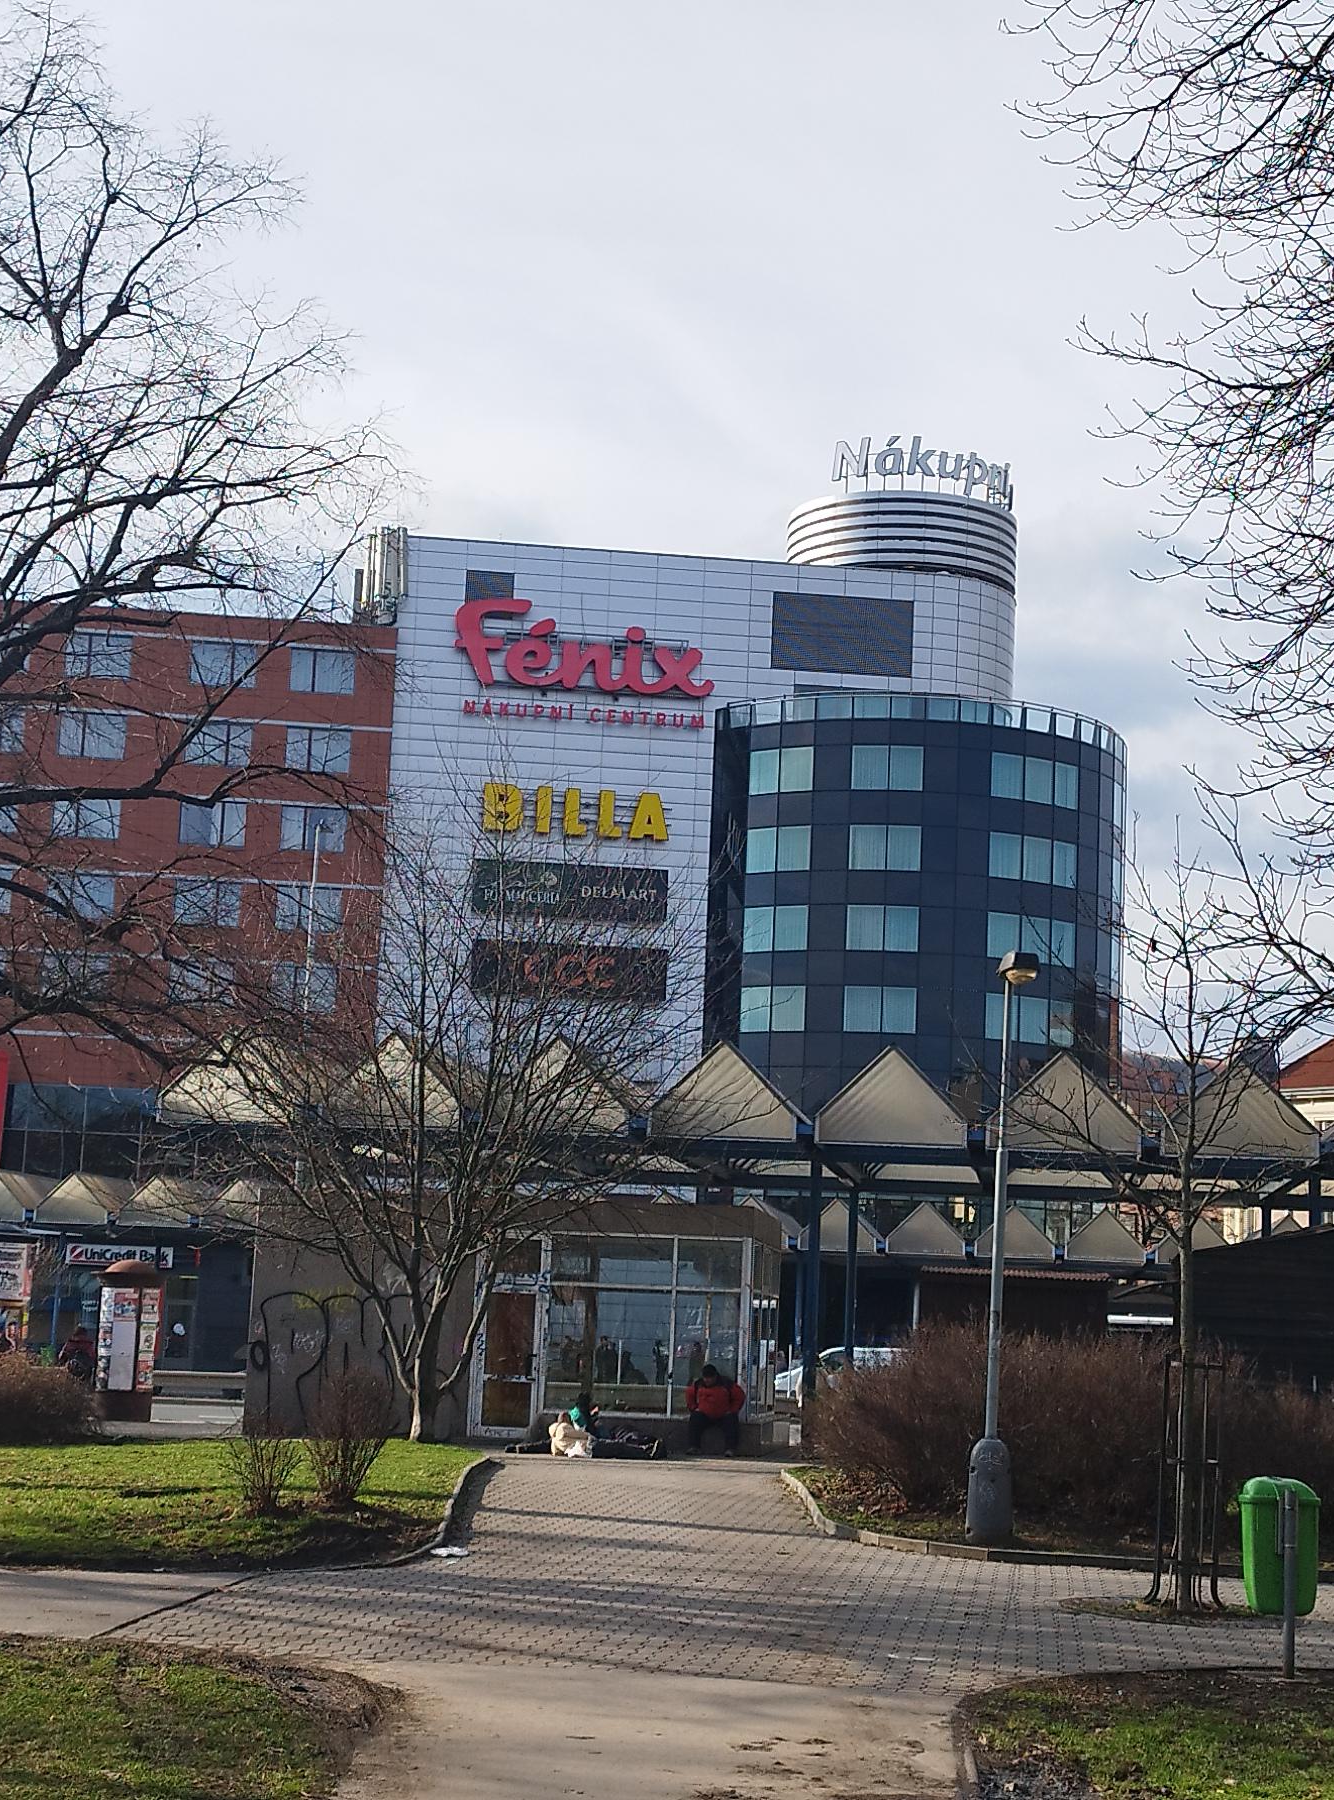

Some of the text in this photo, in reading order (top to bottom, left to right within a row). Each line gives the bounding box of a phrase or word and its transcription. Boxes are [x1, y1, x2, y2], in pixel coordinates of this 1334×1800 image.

[455, 598, 715, 697] Fénix
[463, 699, 705, 729] NÁKUPNÍ CENTRUM
[483, 783, 669, 841] BILLA
[524, 952, 616, 989] CCC
[84, 1248, 170, 1263] UniCredit Bak
